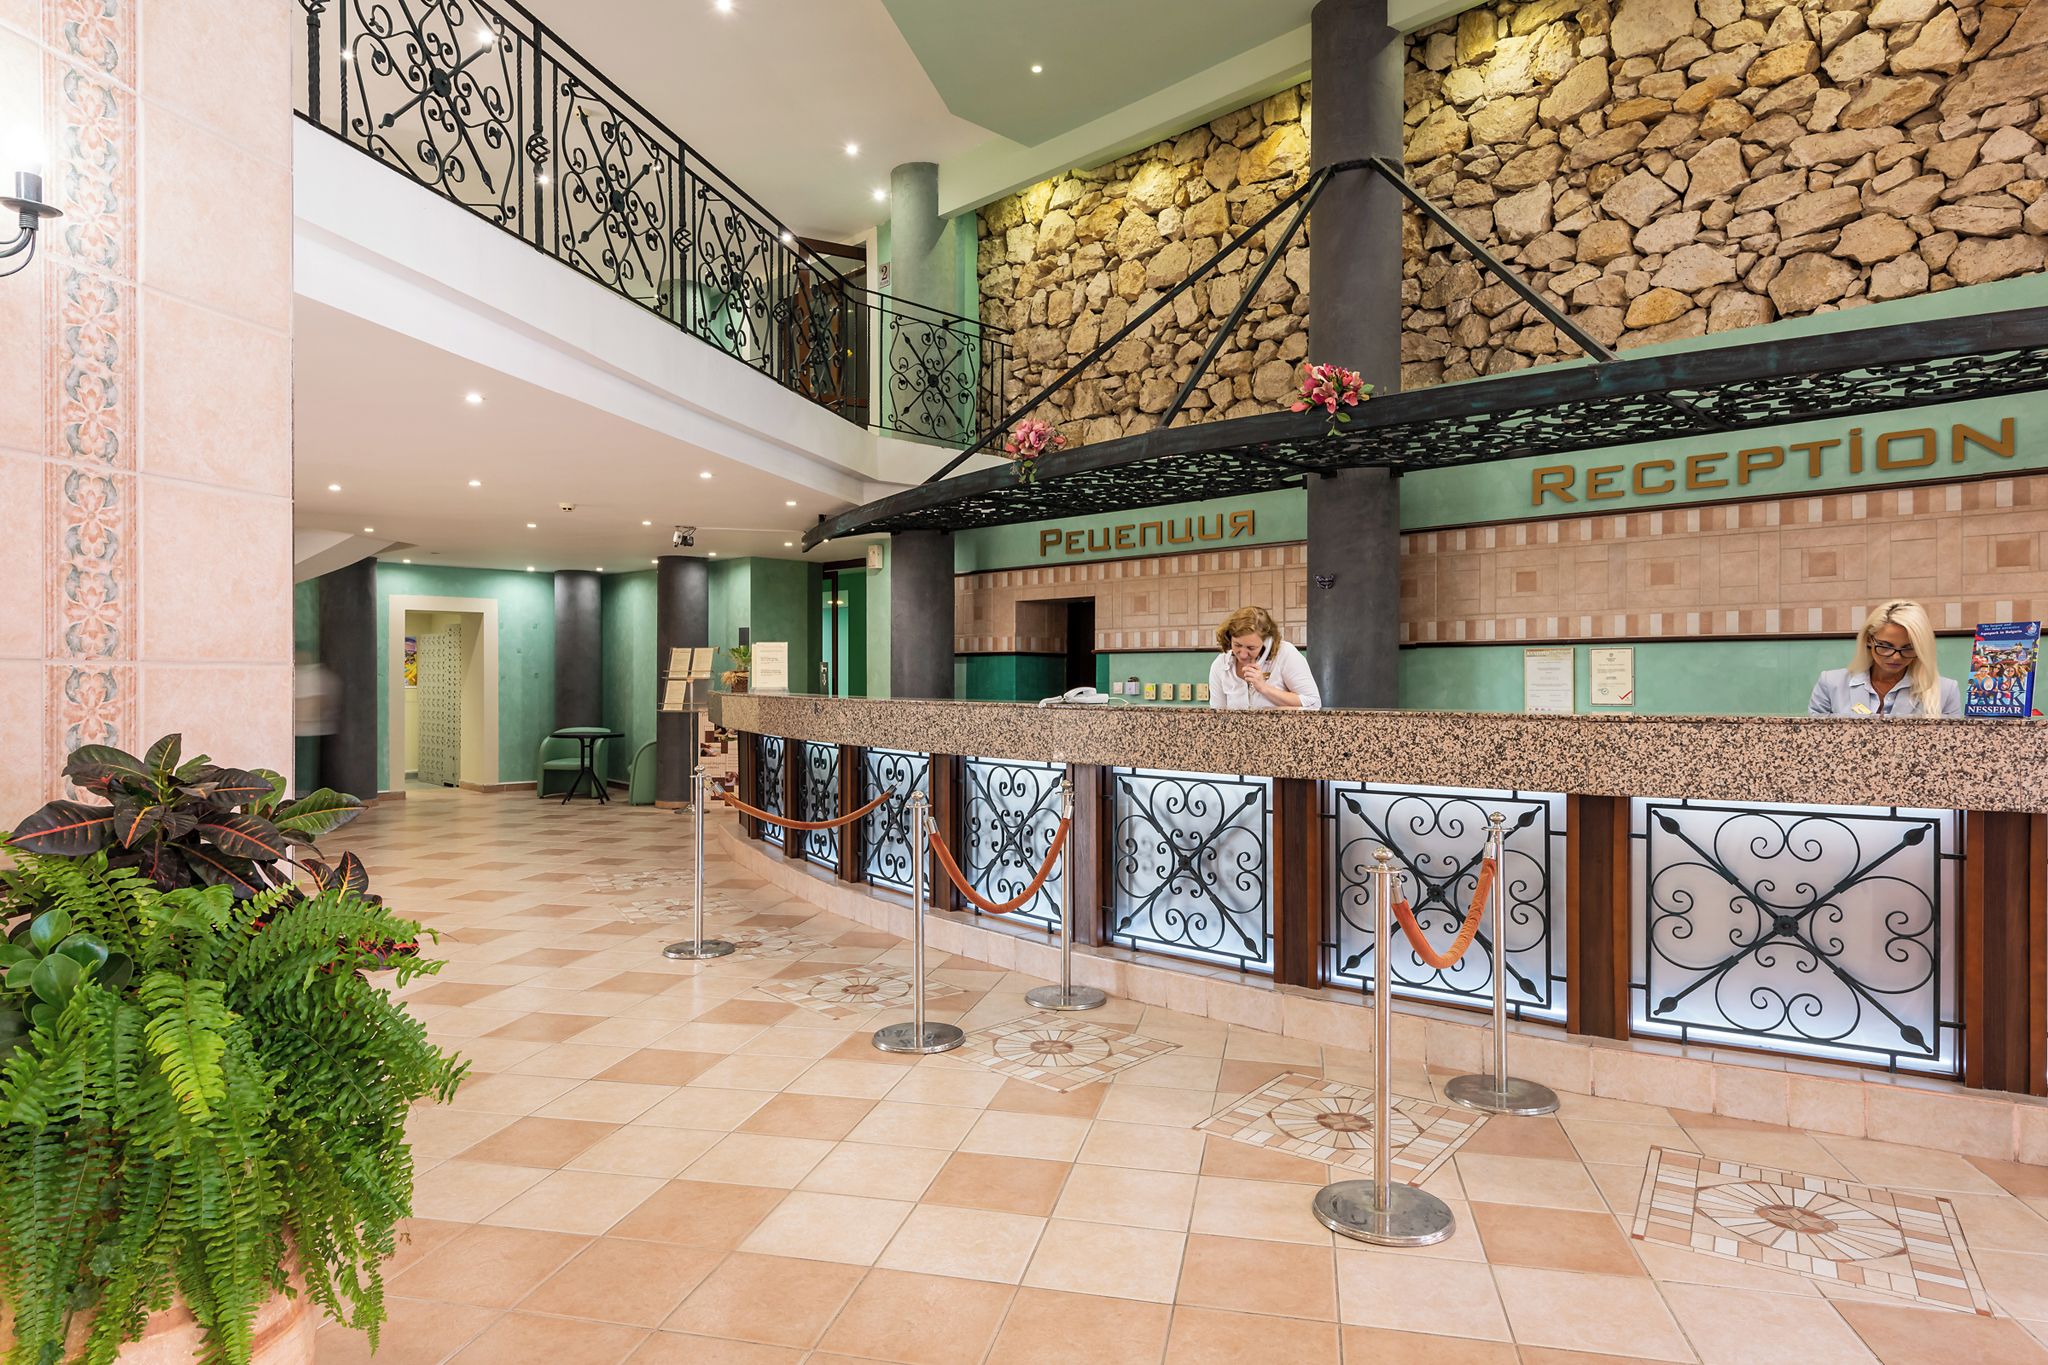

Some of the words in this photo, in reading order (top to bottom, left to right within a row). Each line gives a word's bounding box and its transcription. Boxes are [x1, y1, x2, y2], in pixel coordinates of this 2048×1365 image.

[881, 265, 887, 281] 2
[1967, 691, 2025, 706] PARK
[1967, 705, 2021, 714] NESSEBAR
